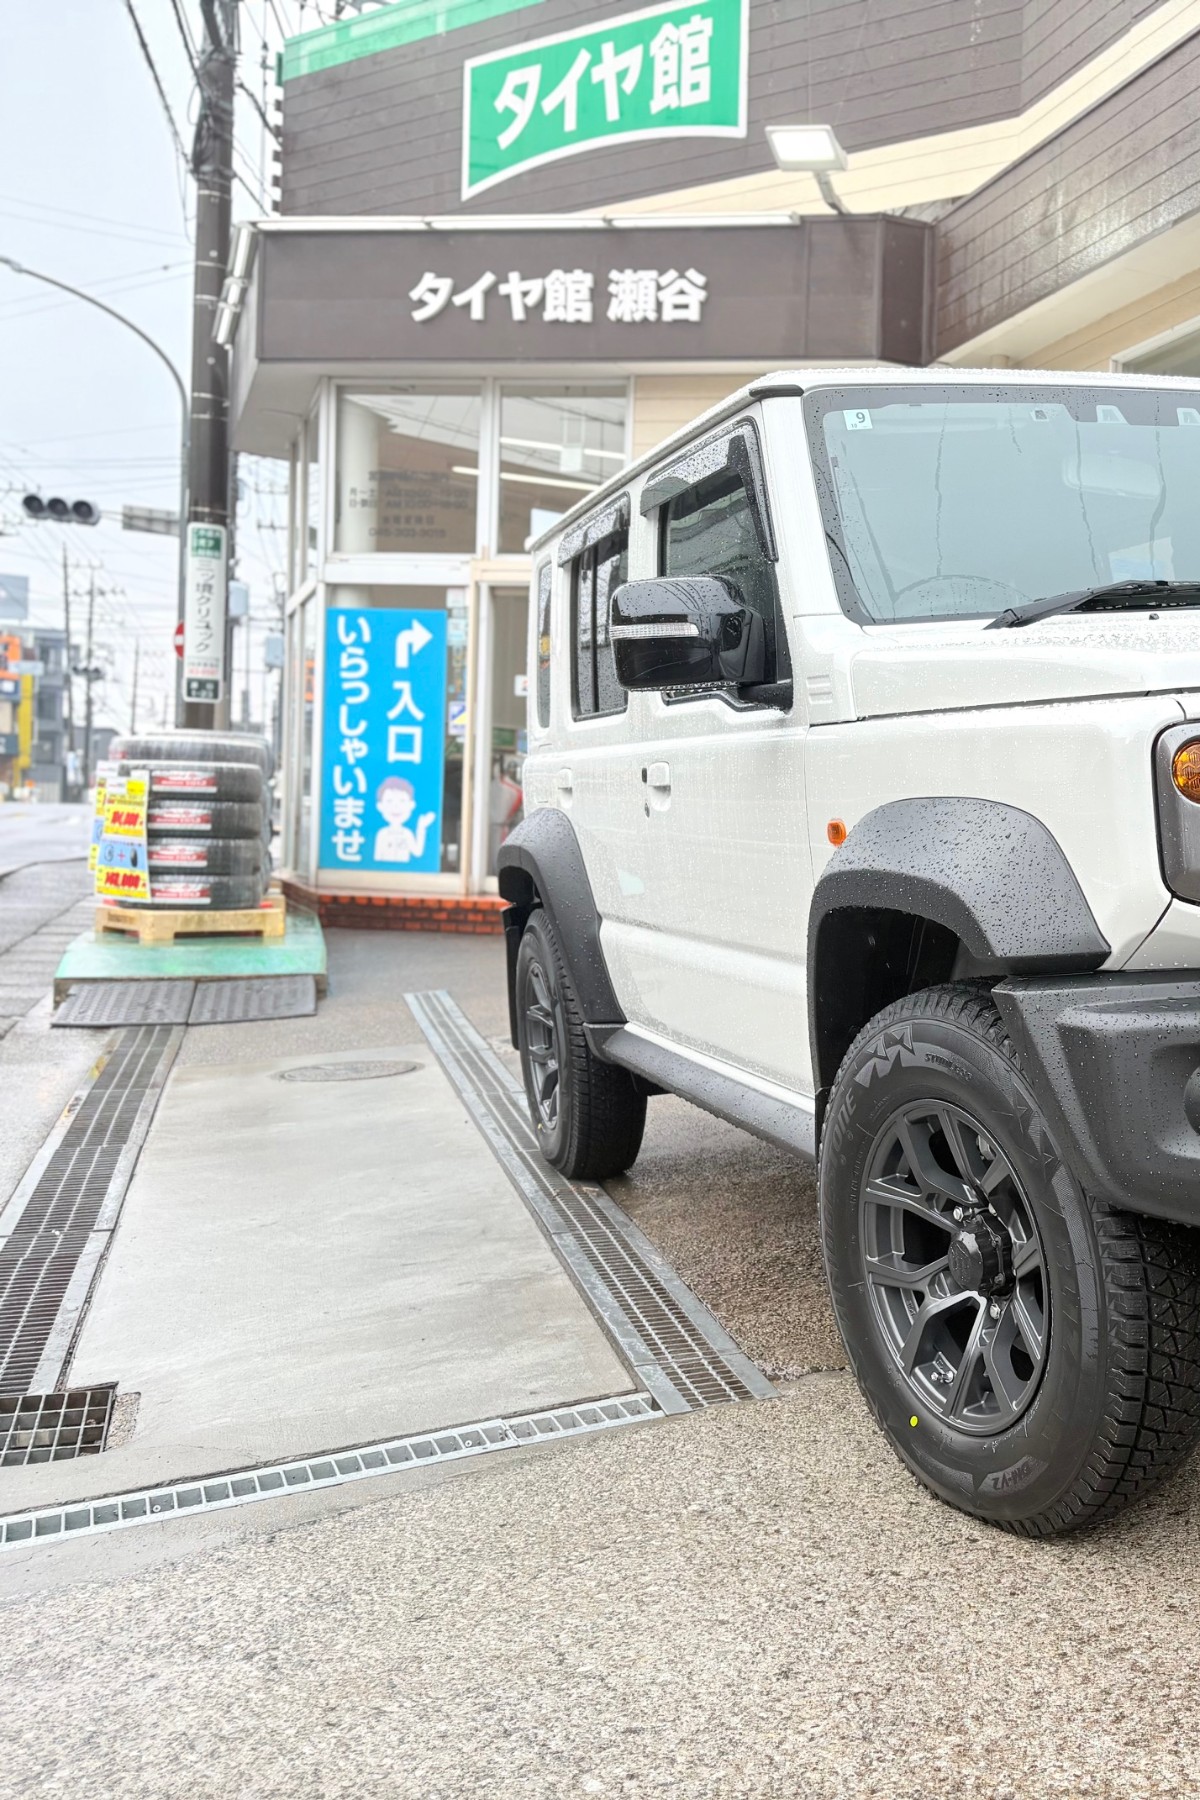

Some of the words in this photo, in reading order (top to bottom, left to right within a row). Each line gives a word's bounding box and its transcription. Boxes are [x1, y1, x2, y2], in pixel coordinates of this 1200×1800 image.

[493, 14, 713, 150] タイヤ館
[408, 269, 595, 322] タイヤ館
[606, 267, 708, 322] 瀬谷
[855, 411, 866, 424] 9
[331, 615, 371, 862] いらっしゃいませ
[386, 681, 425, 764] 入口
